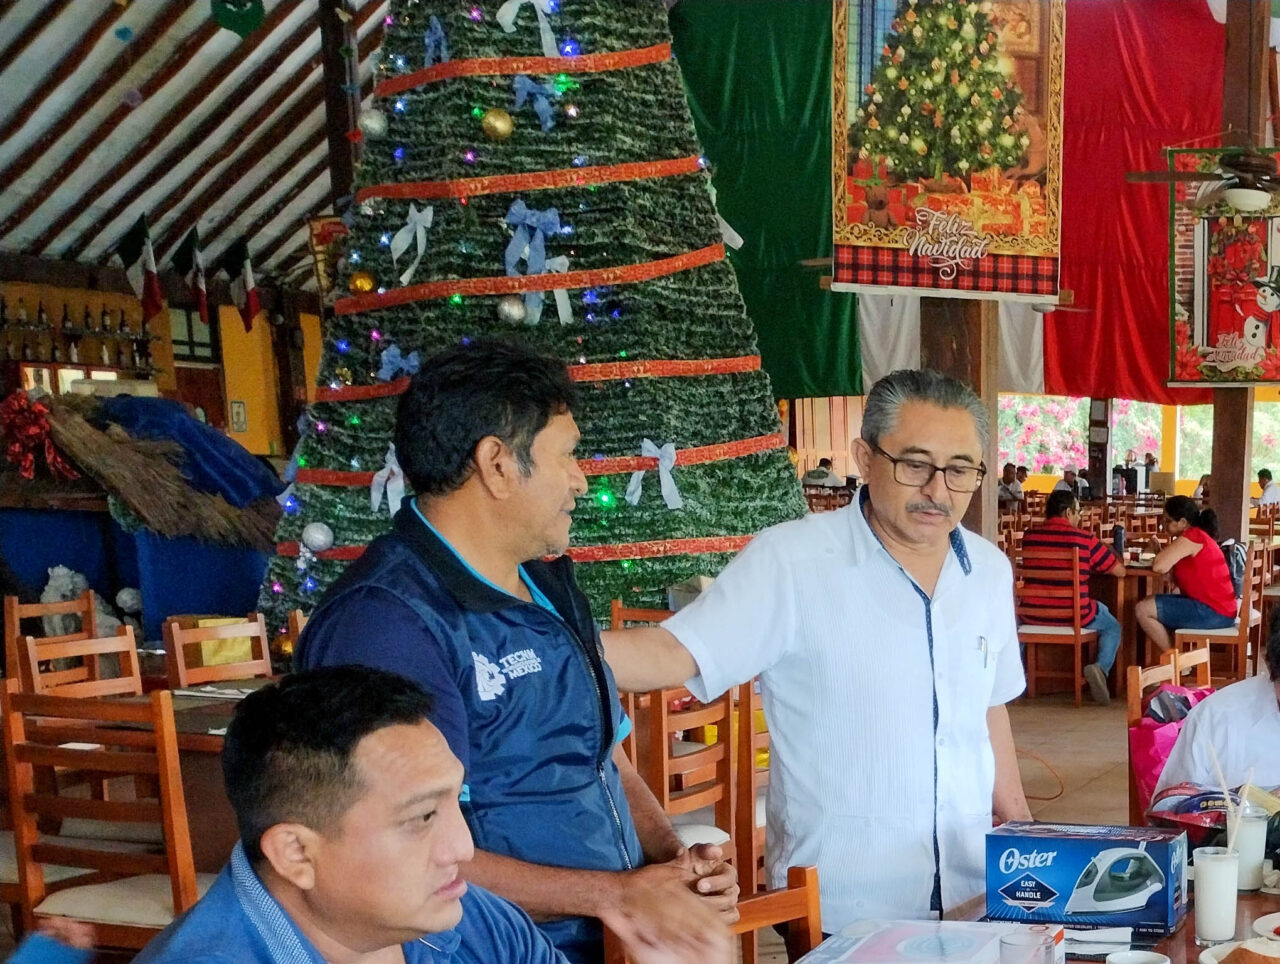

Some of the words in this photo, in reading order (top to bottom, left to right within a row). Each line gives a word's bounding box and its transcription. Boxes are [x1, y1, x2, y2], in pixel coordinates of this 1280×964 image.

[915, 207, 977, 236] Feliz
[903, 228, 990, 264] Navidad
[999, 848, 1058, 874] Oster
[1016, 891, 1041, 899] HANDLE
